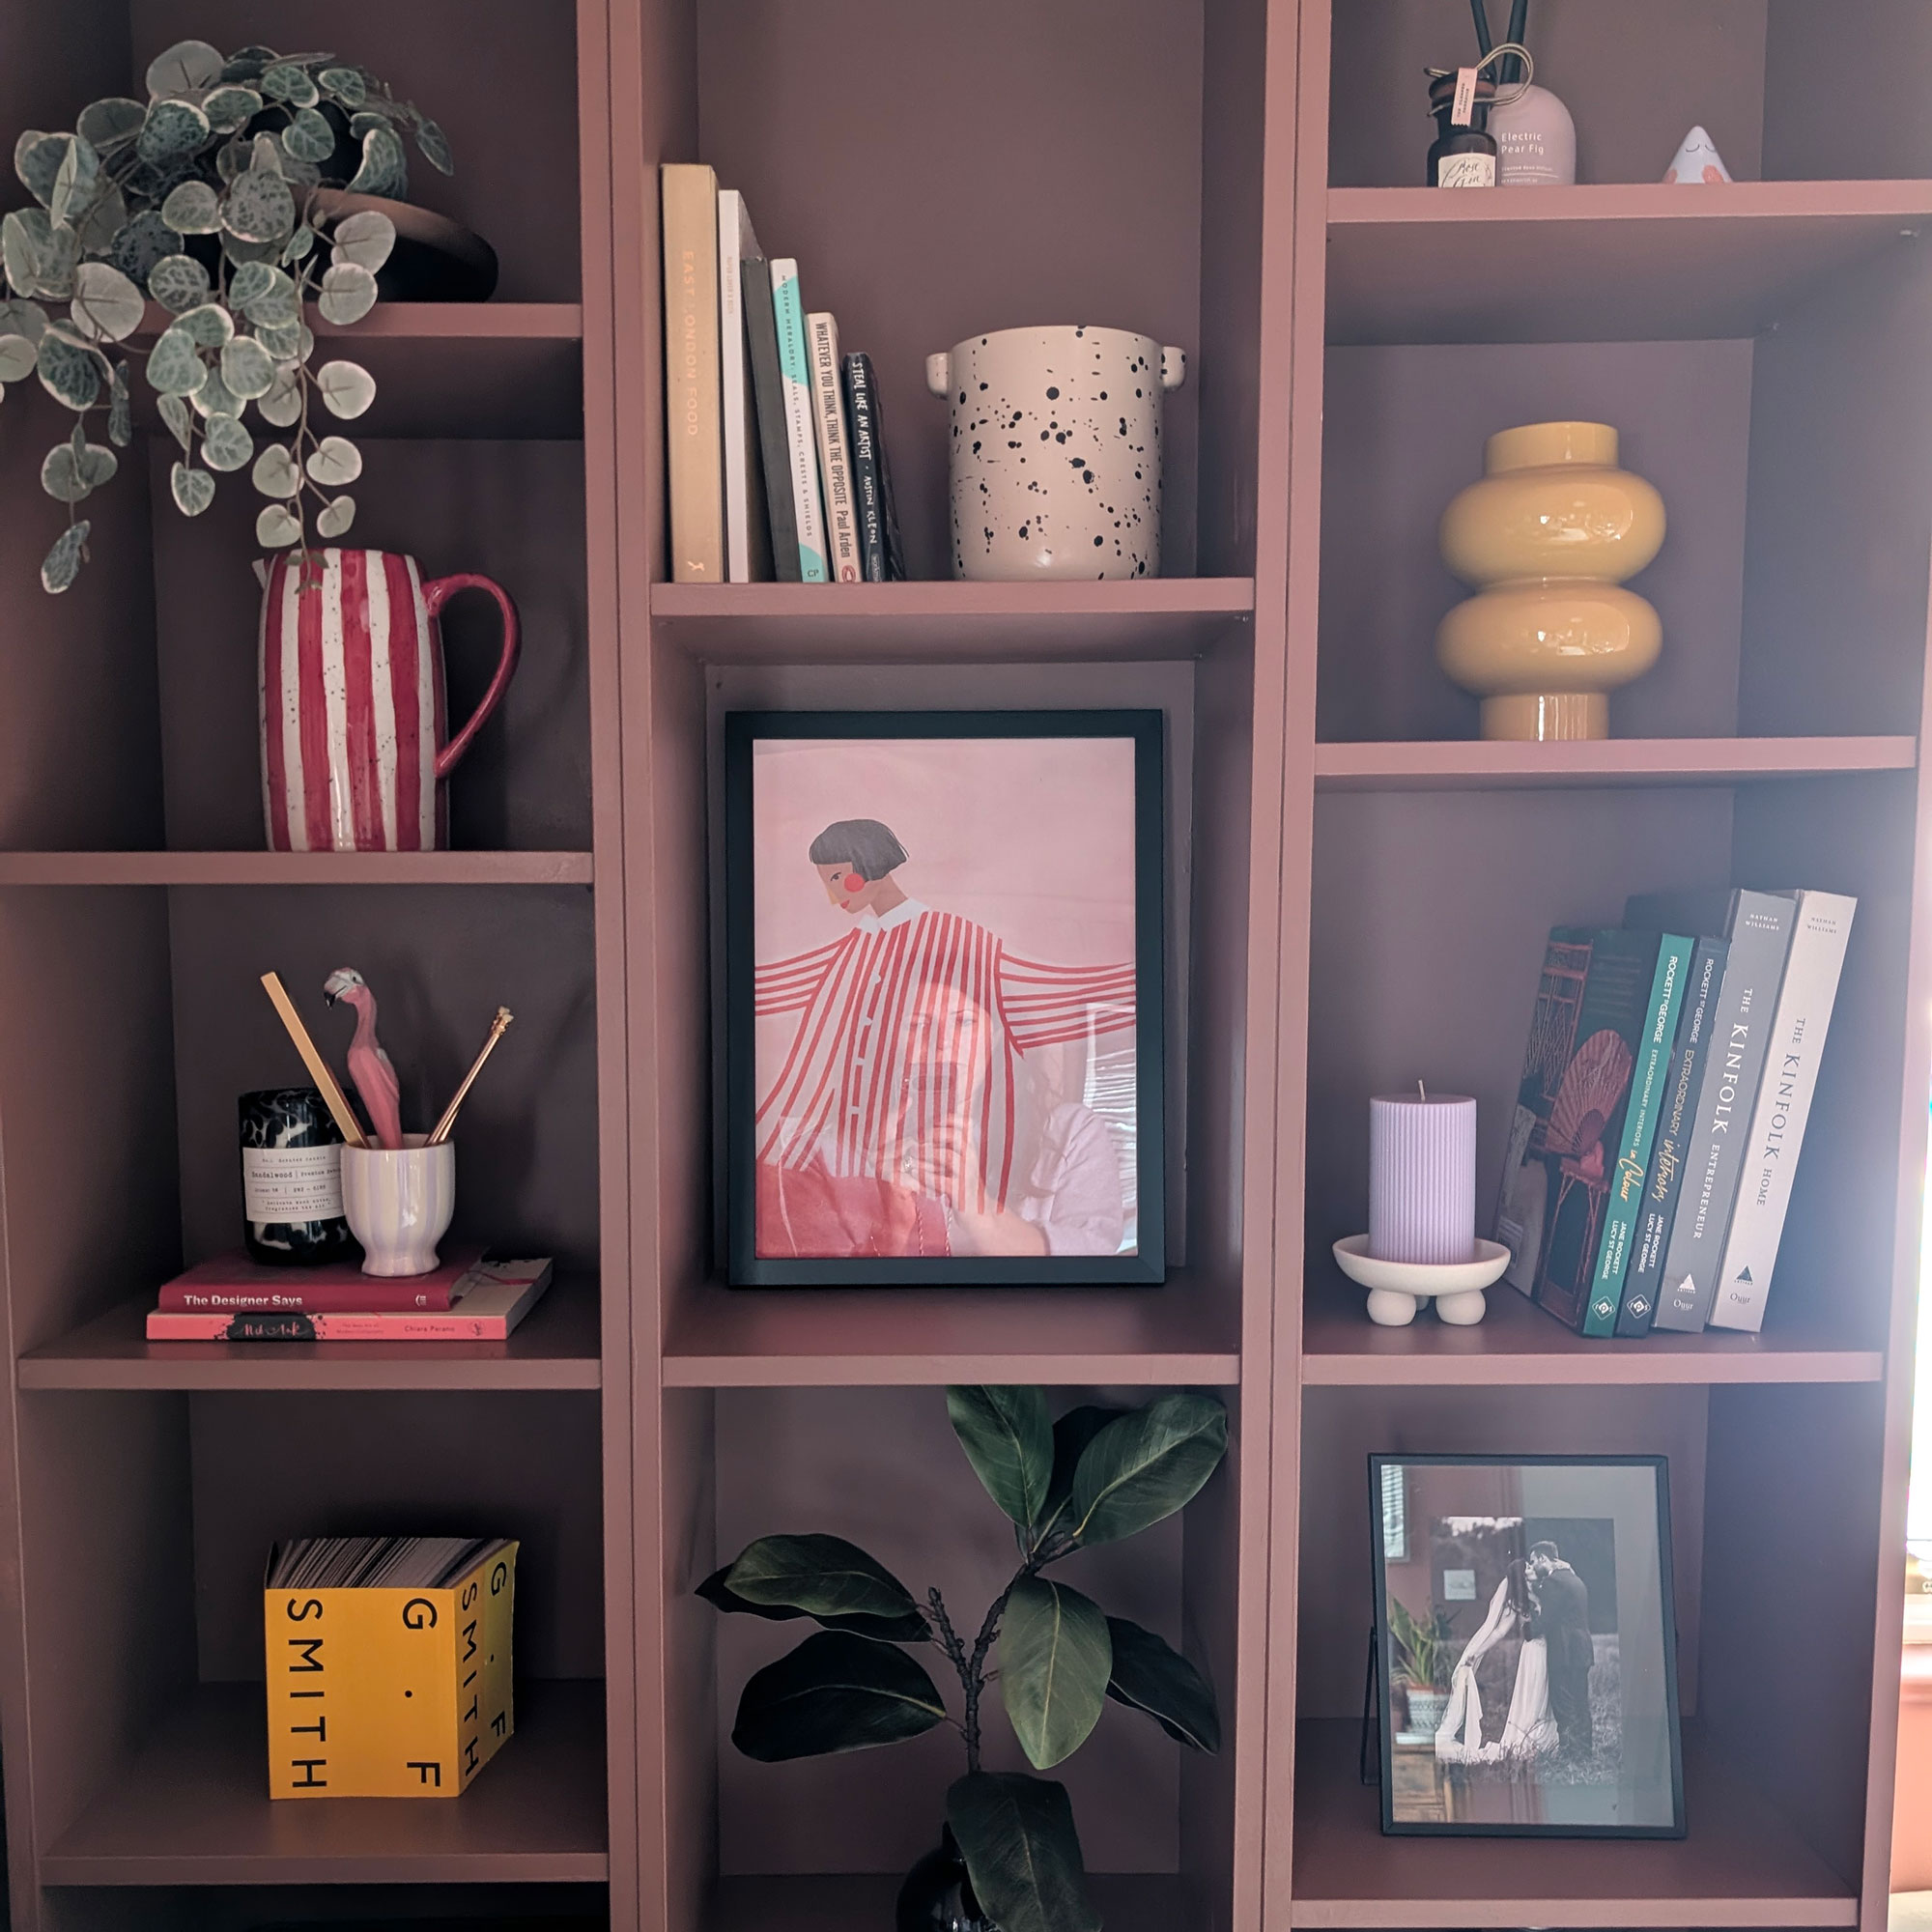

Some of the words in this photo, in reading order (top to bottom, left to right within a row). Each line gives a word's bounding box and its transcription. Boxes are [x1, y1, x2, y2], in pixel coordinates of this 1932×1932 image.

[1501, 132, 1542, 142] Electric
[1501, 145, 1524, 154] Pear
[1529, 145, 1544, 156] Fig
[683, 250, 695, 297] EAST
[815, 322, 831, 368] WHATEVER
[821, 370, 834, 387] YOU
[852, 362, 867, 389] STEAL
[687, 386, 698, 436] FOOD
[781, 275, 790, 314] MODERN
[799, 451, 808, 484] CRESTS
[804, 498, 812, 536] SHIELDS
[823, 389, 838, 418] THINK,
[854, 392, 867, 411] LIKE
[826, 418, 840, 444] THINK
[857, 414, 869, 428] AN
[829, 446, 842, 463] THE
[858, 430, 872, 461] ARTIST
[831, 465, 847, 506] OPPOSITE
[864, 475, 873, 505] AUSTIN
[837, 510, 850, 530] Paul
[867, 510, 878, 544] KLEON
[838, 532, 852, 557] Arden
[1745, 921, 1779, 931] WILLIAMS
[1749, 913, 1778, 923] NATHAN
[1806, 924, 1837, 934] WILLIAMS
[1810, 917, 1836, 925] NATHAN
[1662, 955, 1678, 999] ROCKETT
[1700, 958, 1714, 999] ROCKETT
[1740, 988, 1753, 1013] THE
[1653, 1004, 1668, 1043] GEORGE
[1690, 1008, 1703, 1043] GEORGE
[1792, 1018, 1805, 1044] THE
[1642, 1049, 1658, 1107] EXTRAORDINARY
[1669, 1049, 1694, 1136] EXTRAORDINARY
[1712, 1023, 1748, 1134] KINFOLK
[1764, 1054, 1801, 1160] KINFOLK
[1634, 1109, 1646, 1148] INTERIORS
[1618, 1157, 1643, 1202] Colour
[1693, 1144, 1720, 1238] ENTREPRENEUR
[1757, 1169, 1772, 1207] HOME
[1608, 1220, 1619, 1239] LUCY
[1618, 1221, 1627, 1240] JANE
[1644, 1233, 1652, 1242] ST
[1646, 1213, 1655, 1233] LUCY
[1655, 1214, 1664, 1234] JANE
[1607, 1239, 1615, 1249] ST
[1611, 1241, 1623, 1275] ROCKETT
[1637, 1243, 1649, 1273] GEORGE
[1648, 1235, 1661, 1268] ROCKETT
[1602, 1250, 1613, 1280] GEORGE
[184, 1295, 208, 1305] The
[212, 1295, 269, 1308] Designer
[272, 1295, 302, 1307] Says
[287, 1598, 327, 1787] SMITH
[462, 1581, 479, 1776] SMITH
